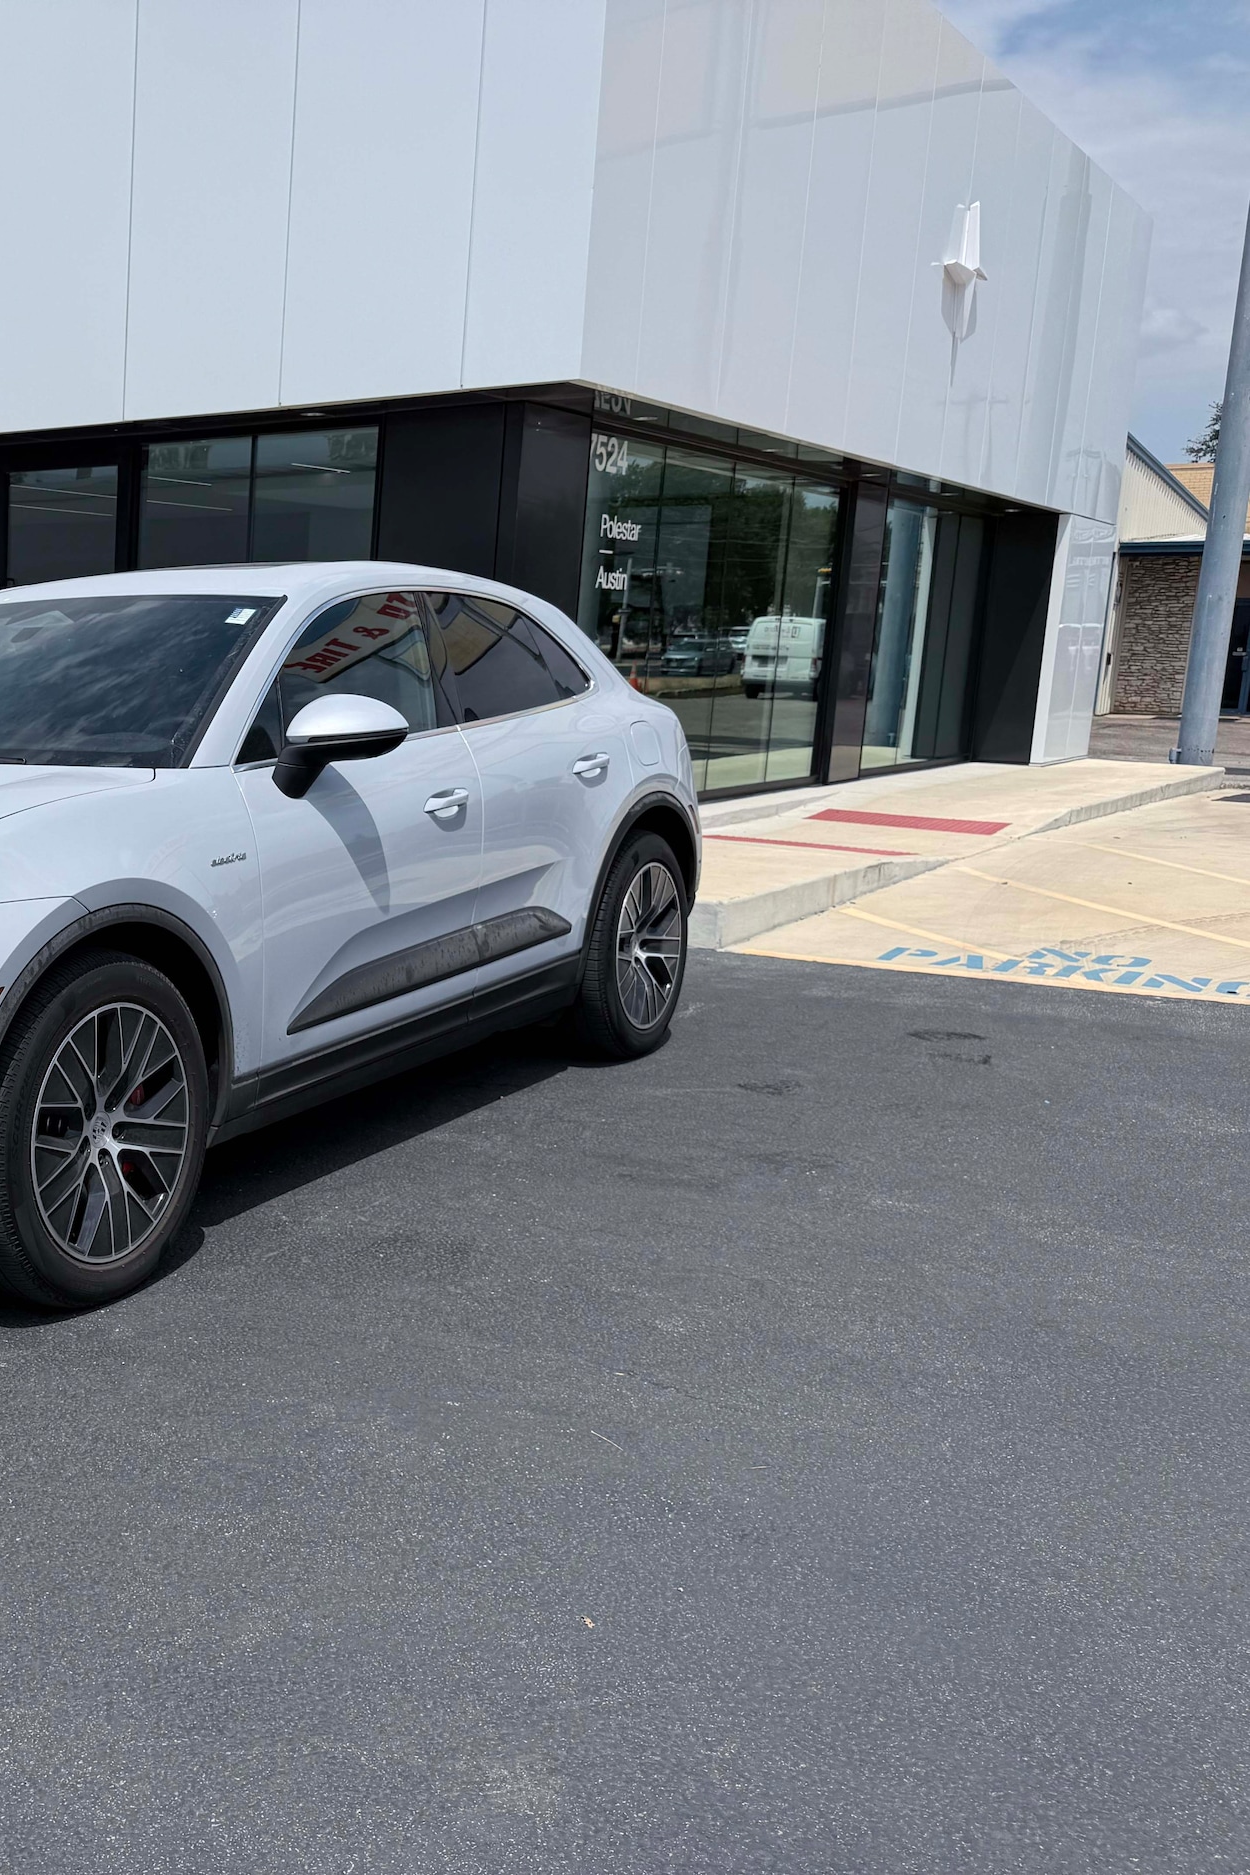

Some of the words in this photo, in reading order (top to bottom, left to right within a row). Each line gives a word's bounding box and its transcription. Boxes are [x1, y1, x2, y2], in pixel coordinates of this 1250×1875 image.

[600, 513, 641, 541] Polestar
[595, 565, 628, 591] Austin
[1025, 946, 1153, 969] NO
